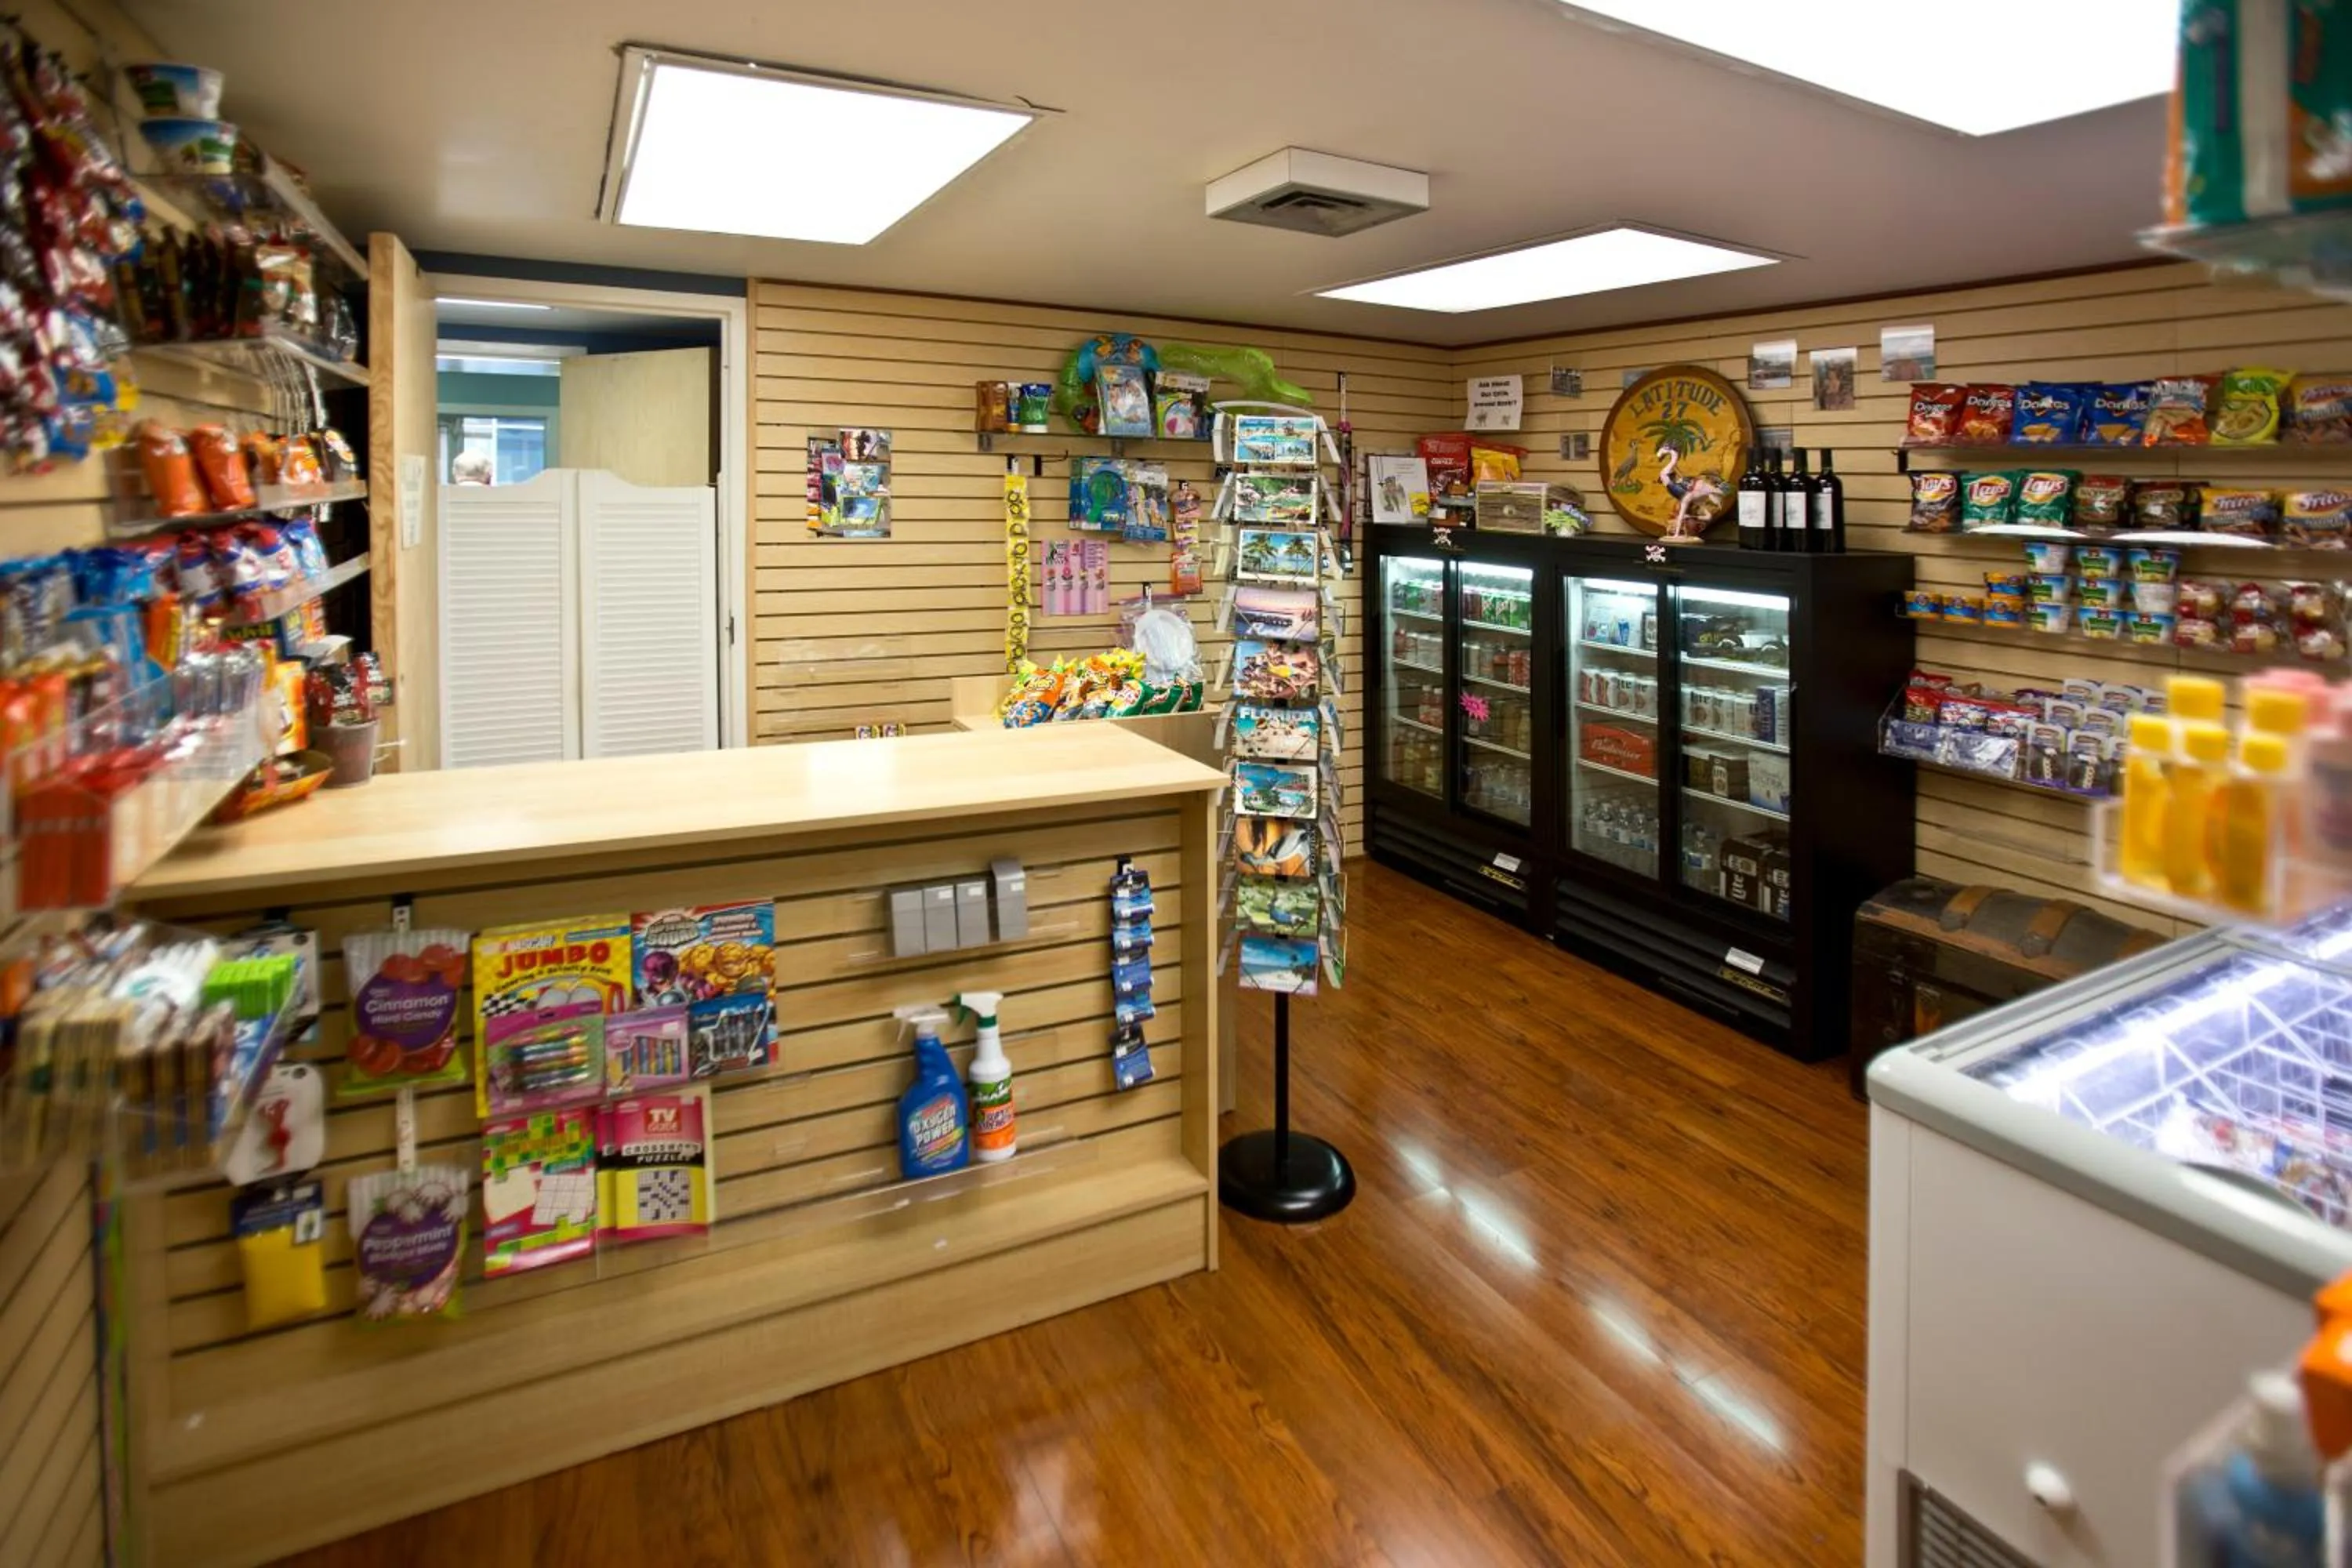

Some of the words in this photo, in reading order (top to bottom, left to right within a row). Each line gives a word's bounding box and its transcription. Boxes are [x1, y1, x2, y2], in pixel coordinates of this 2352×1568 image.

[1629, 380, 1727, 418] LATITUDE
[1967, 395, 2013, 409] Doritos
[2020, 399, 2071, 411] Doritos
[2094, 397, 2147, 411] Doritos
[1661, 401, 1690, 419] 27
[1239, 706, 1316, 722] FLORIDA
[495, 940, 612, 979] JUMBO
[364, 994, 449, 1014] Cinnamon
[402, 1007, 445, 1022] Candy
[648, 1107, 678, 1123] TV
[909, 1102, 956, 1136] OXYGEN
[915, 1116, 956, 1146] POWER
[362, 1223, 453, 1253] Peppermint
